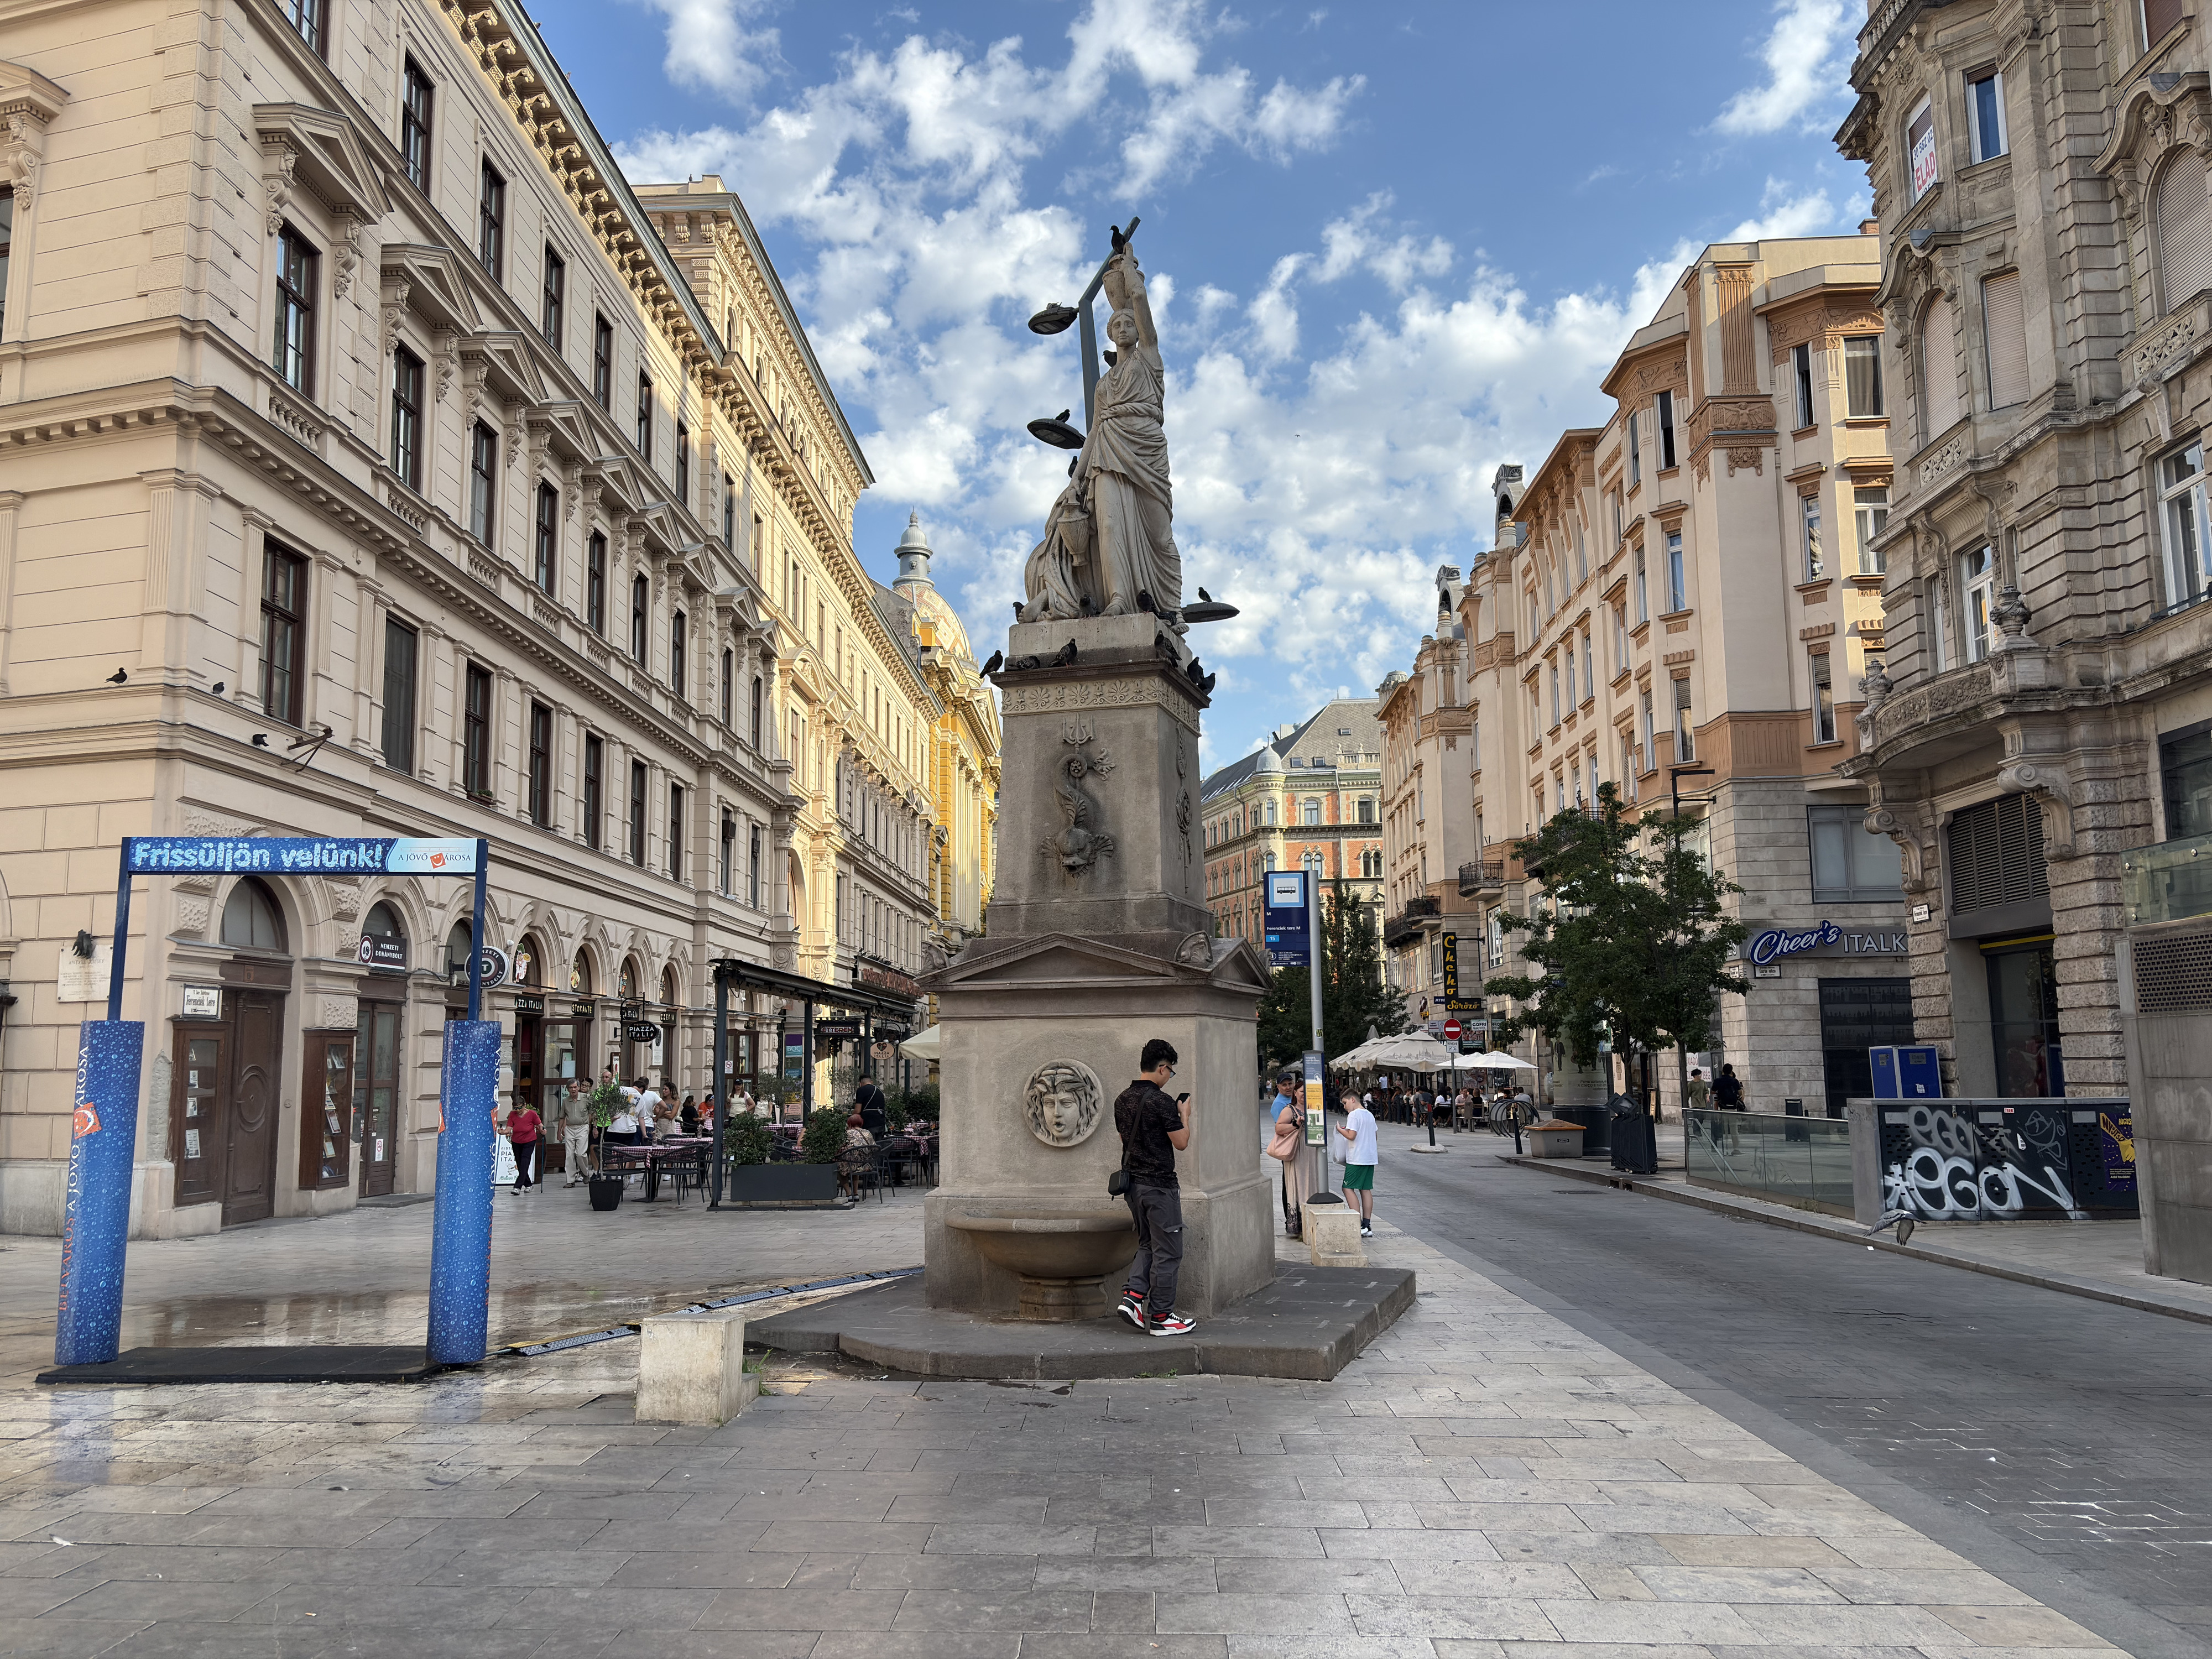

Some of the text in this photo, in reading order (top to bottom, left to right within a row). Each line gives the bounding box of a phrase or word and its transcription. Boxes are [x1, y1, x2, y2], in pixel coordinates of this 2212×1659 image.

[1913, 148, 1919, 161] 30
[1919, 135, 1927, 154] 562
[134, 842, 383, 872] Frissüljön velünk!
[406, 853, 428, 862] JÖVŐ
[380, 943, 399, 951] NEMZETI
[1754, 921, 1841, 964] Cheer's
[375, 950, 403, 959] DOHÁNYBOLT
[572, 1004, 592, 1014] STORANTE
[1447, 1000, 1480, 1010] Söröző
